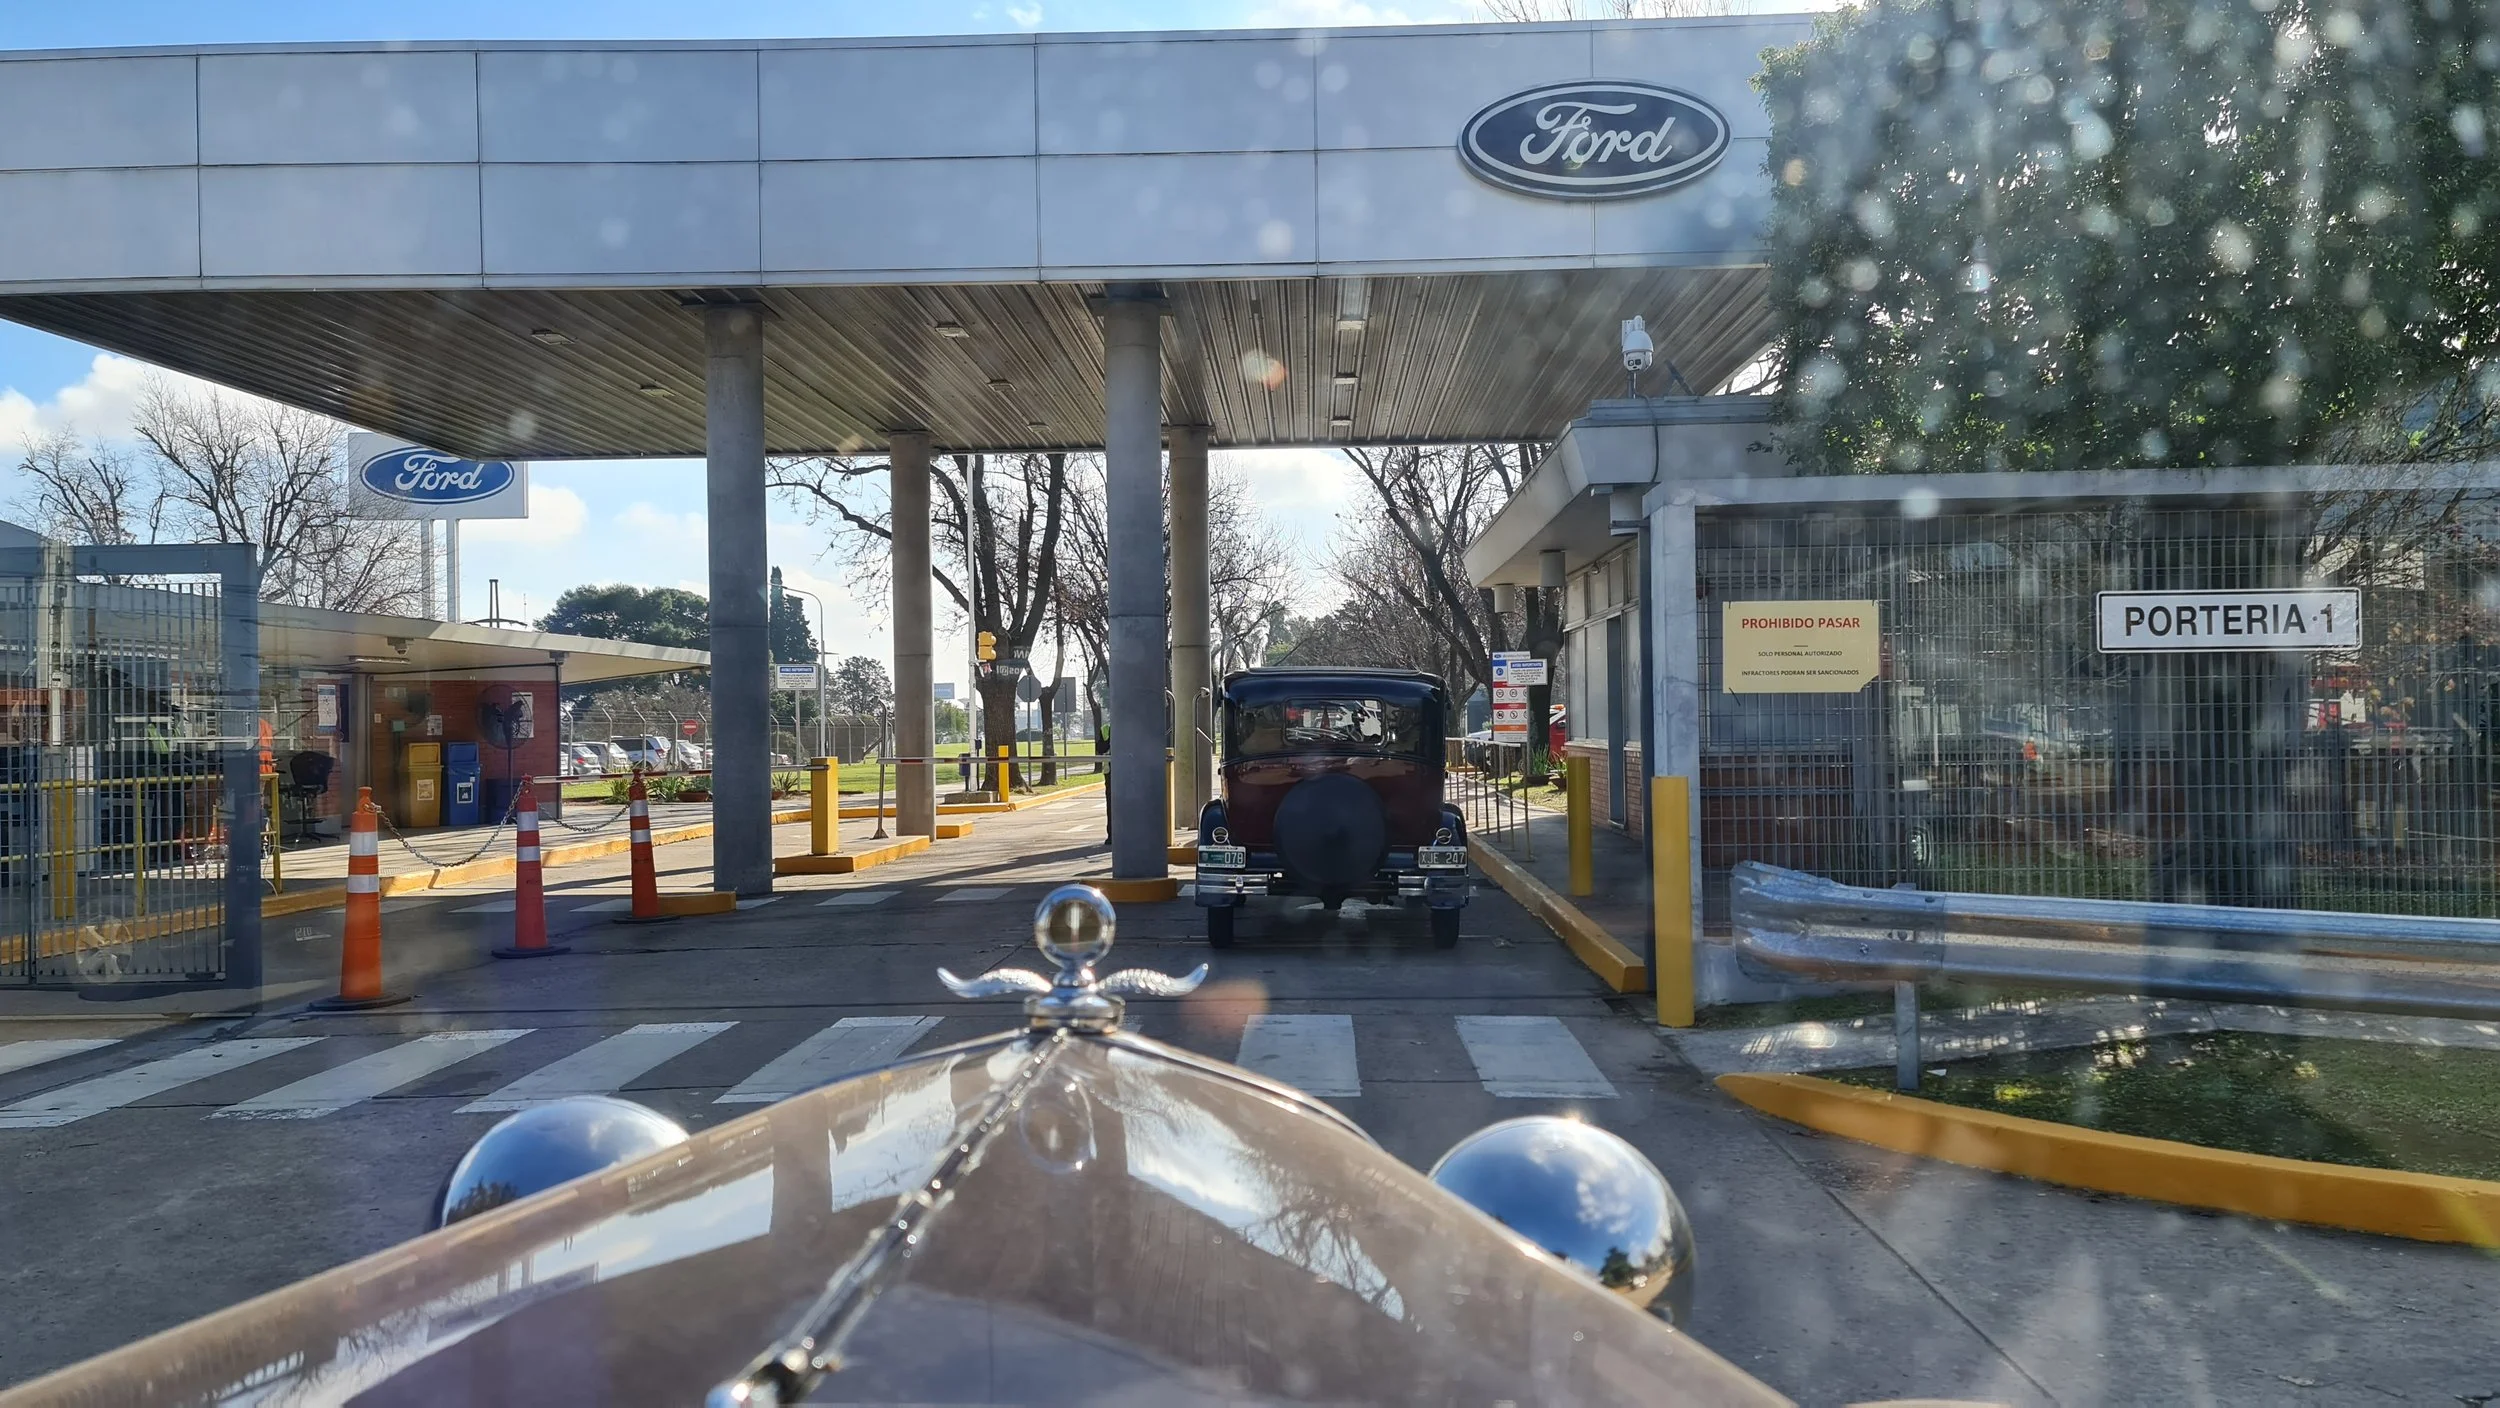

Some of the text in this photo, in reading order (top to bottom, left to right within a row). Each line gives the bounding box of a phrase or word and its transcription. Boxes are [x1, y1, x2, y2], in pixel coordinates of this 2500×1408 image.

[1519, 101, 1677, 165] Ford
[394, 453, 485, 491] Ford
[1741, 617, 1861, 629] PROHIBIDO PASAR
[2125, 603, 2334, 637] PORTERIA 1
[1224, 852, 1244, 864] 078
[1420, 852, 1465, 864] XJE 247
